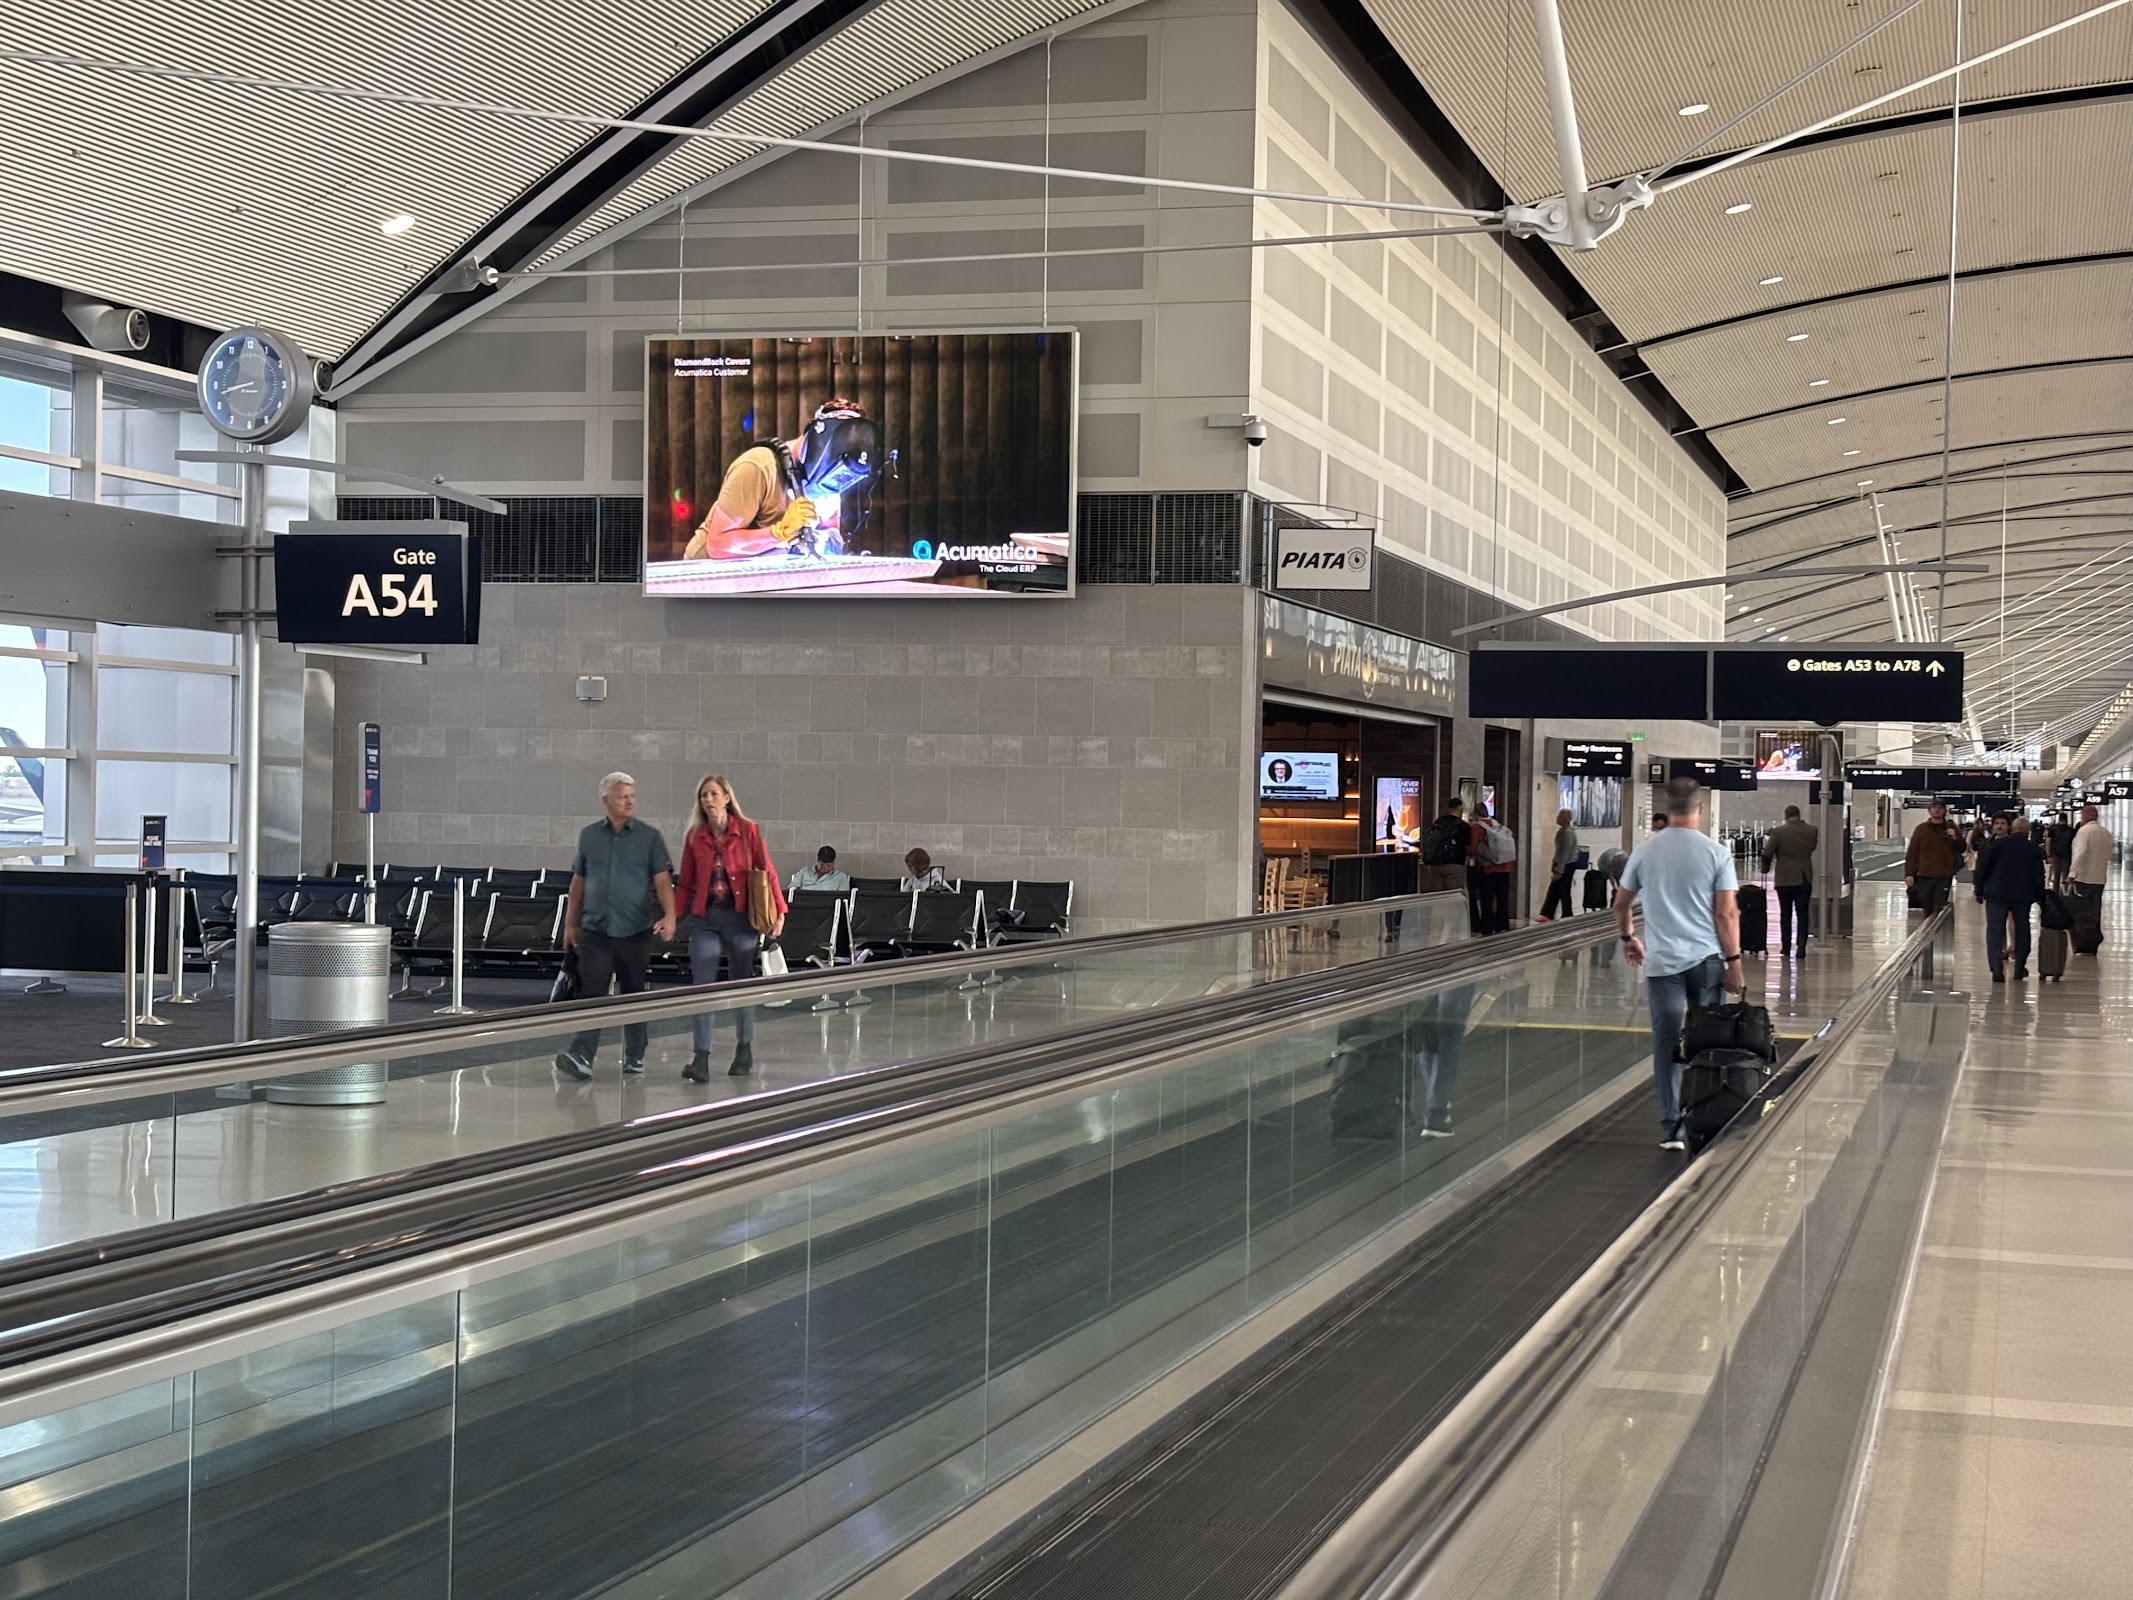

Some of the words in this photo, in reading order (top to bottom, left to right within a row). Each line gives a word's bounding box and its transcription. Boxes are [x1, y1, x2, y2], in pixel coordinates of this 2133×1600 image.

[247, 341, 254, 349] 12
[229, 346, 234, 354] 11
[216, 361, 223, 369] 10
[674, 358, 724, 366] DiamondBack
[674, 368, 712, 376] Acumatica
[714, 368, 749, 376] Customer
[213, 381, 218, 389] 9
[282, 380, 286, 389] 3
[217, 401, 221, 410] 8
[230, 416, 234, 424] 7
[264, 416, 268, 424] 5
[247, 421, 251, 429] 6
[935, 542, 1038, 561] Acumatica
[393, 548, 436, 565] Gate
[1281, 552, 1345, 569] PIATA
[979, 565, 994, 573] The
[995, 564, 1018, 573] Cloud
[1019, 564, 1037, 573] ERP
[341, 574, 438, 617] A54
[1333, 643, 1361, 679] PIATA
[1803, 659, 1842, 672] Gates
[1844, 659, 1872, 672] A53
[1875, 660, 1890, 672] to
[1892, 660, 1921, 672] A78
[1567, 744, 1589, 753] Family
[2108, 787, 2129, 796] A57
